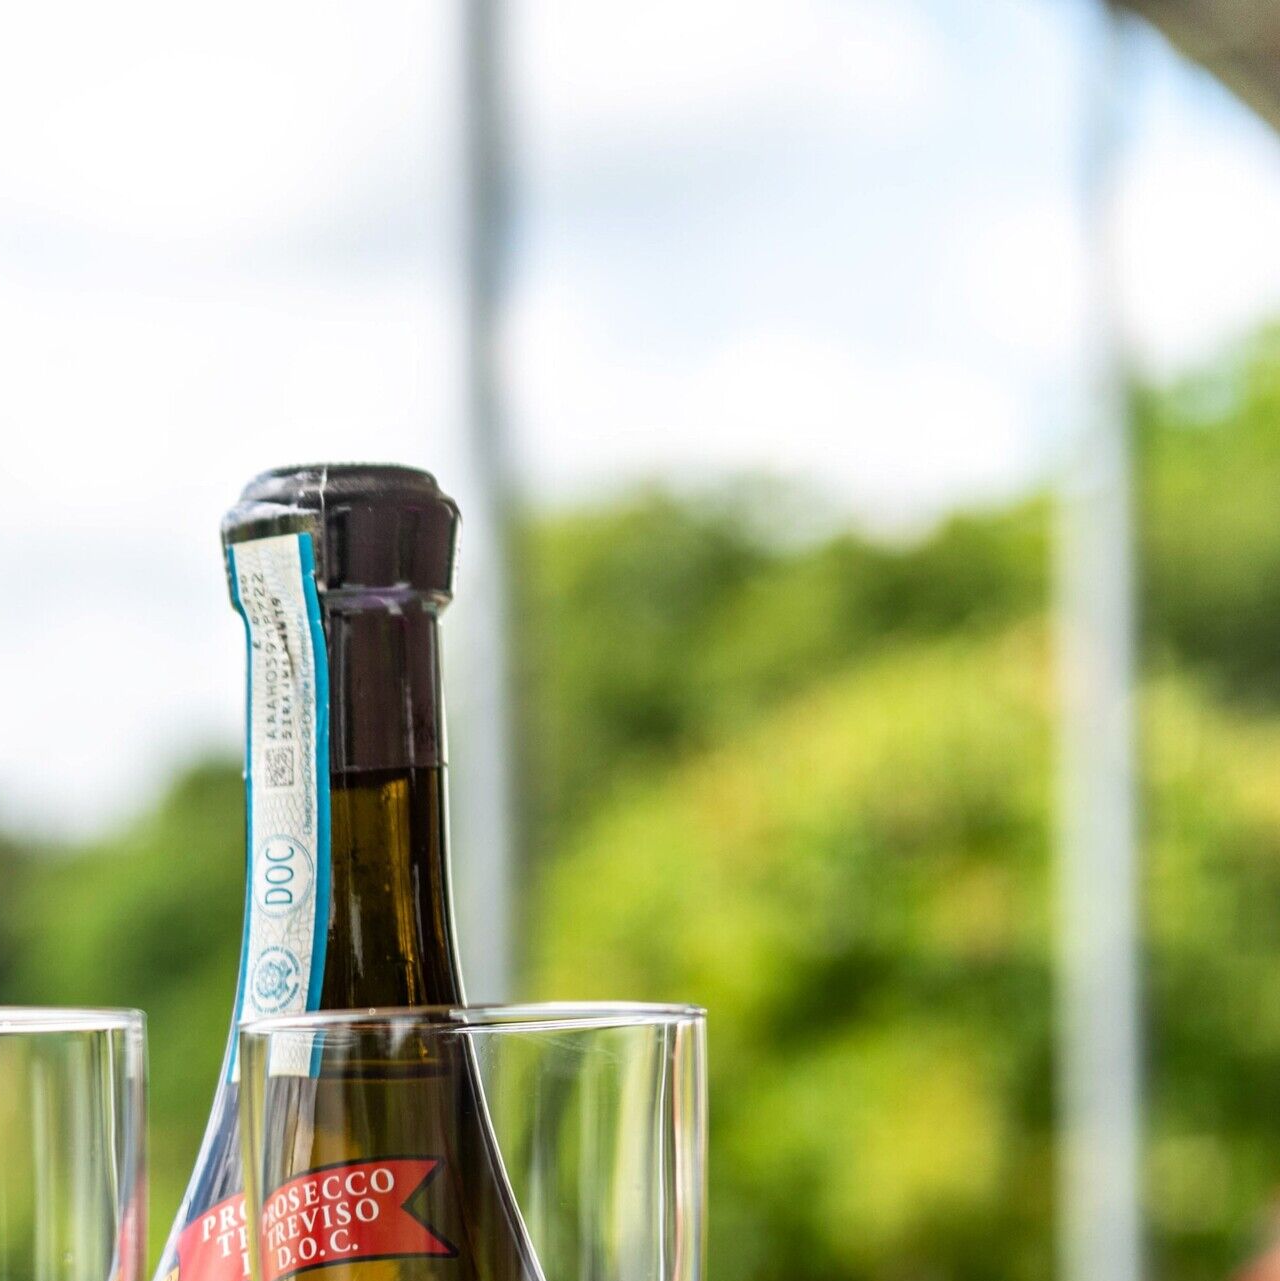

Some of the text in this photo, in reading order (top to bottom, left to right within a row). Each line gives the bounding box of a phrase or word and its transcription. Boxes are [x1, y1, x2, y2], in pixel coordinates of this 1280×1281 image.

[265, 844, 294, 905] DOC
[261, 1168, 395, 1236] PROSECCO
[266, 1198, 380, 1252] TREVISO
[277, 1228, 359, 1271] D.O.C.
